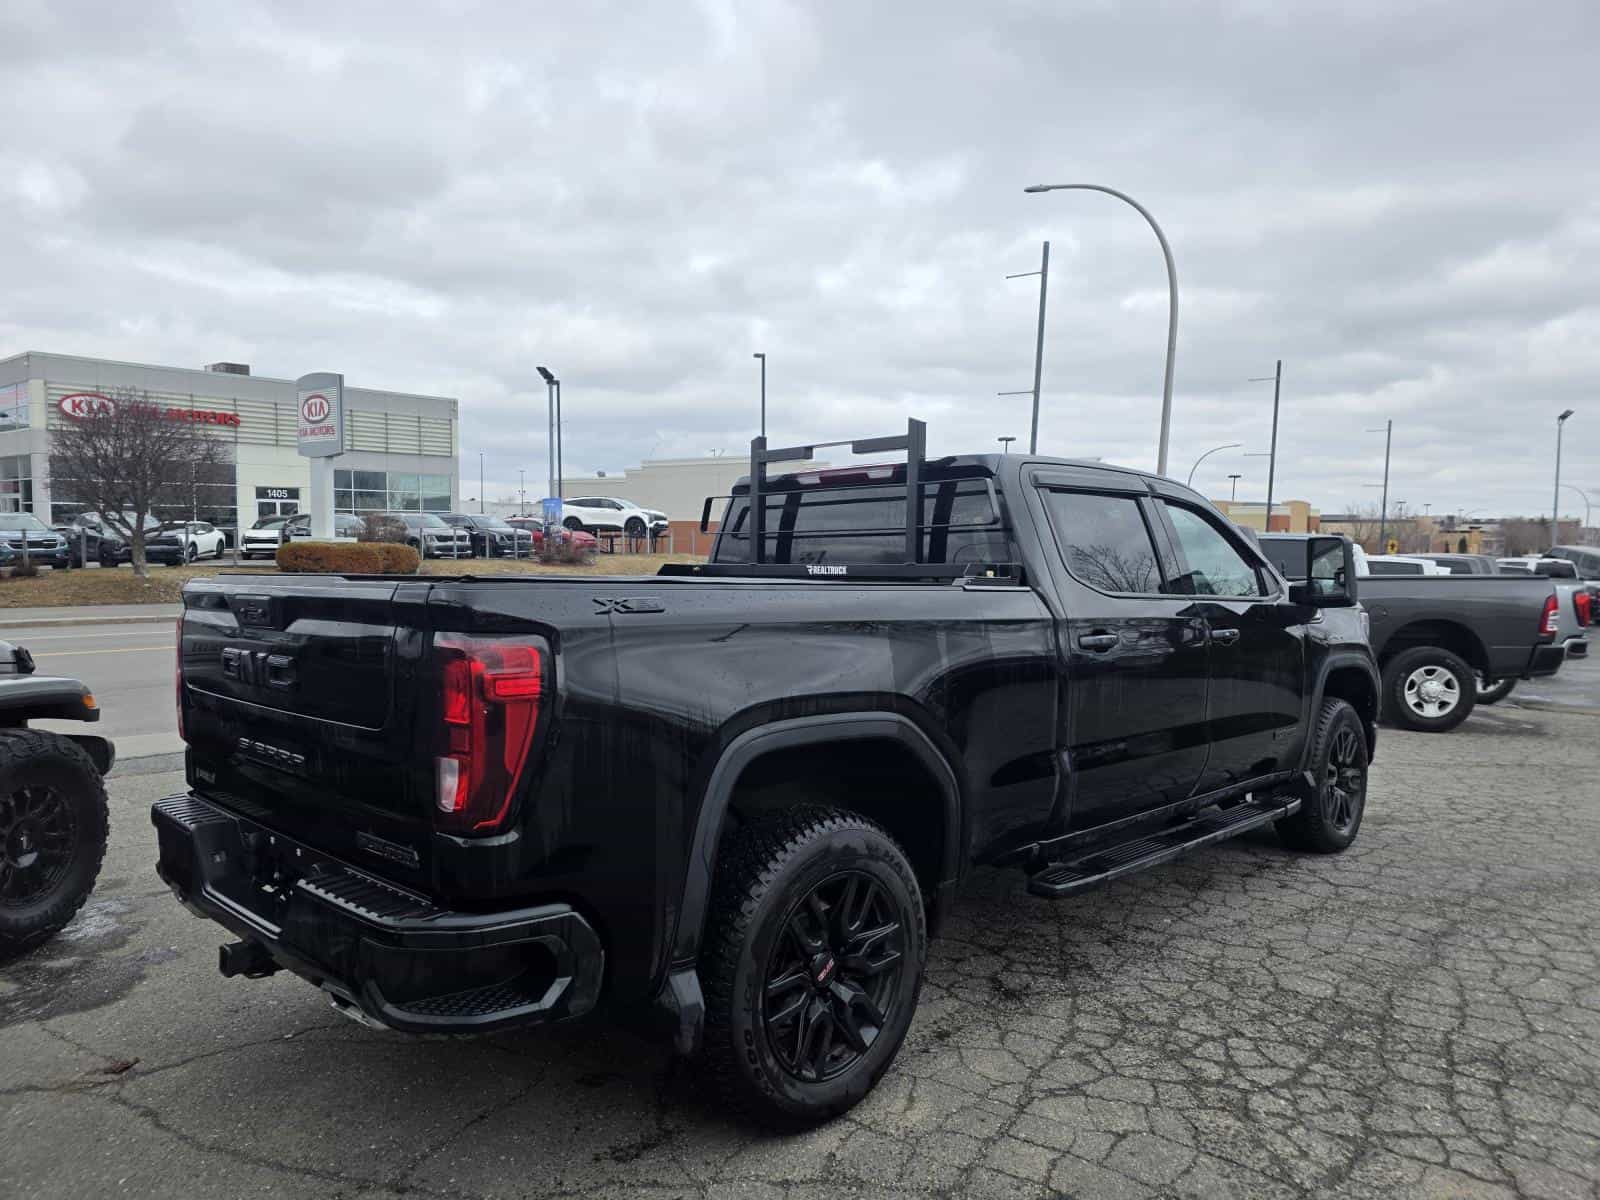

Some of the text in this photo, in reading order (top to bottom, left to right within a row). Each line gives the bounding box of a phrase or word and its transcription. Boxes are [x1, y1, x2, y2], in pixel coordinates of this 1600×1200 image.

[71, 399, 111, 416] KIA
[306, 401, 326, 417] KIA
[267, 489, 288, 498] 1405
[813, 565, 848, 575] REALTRUCK
[223, 648, 296, 686] GMC
